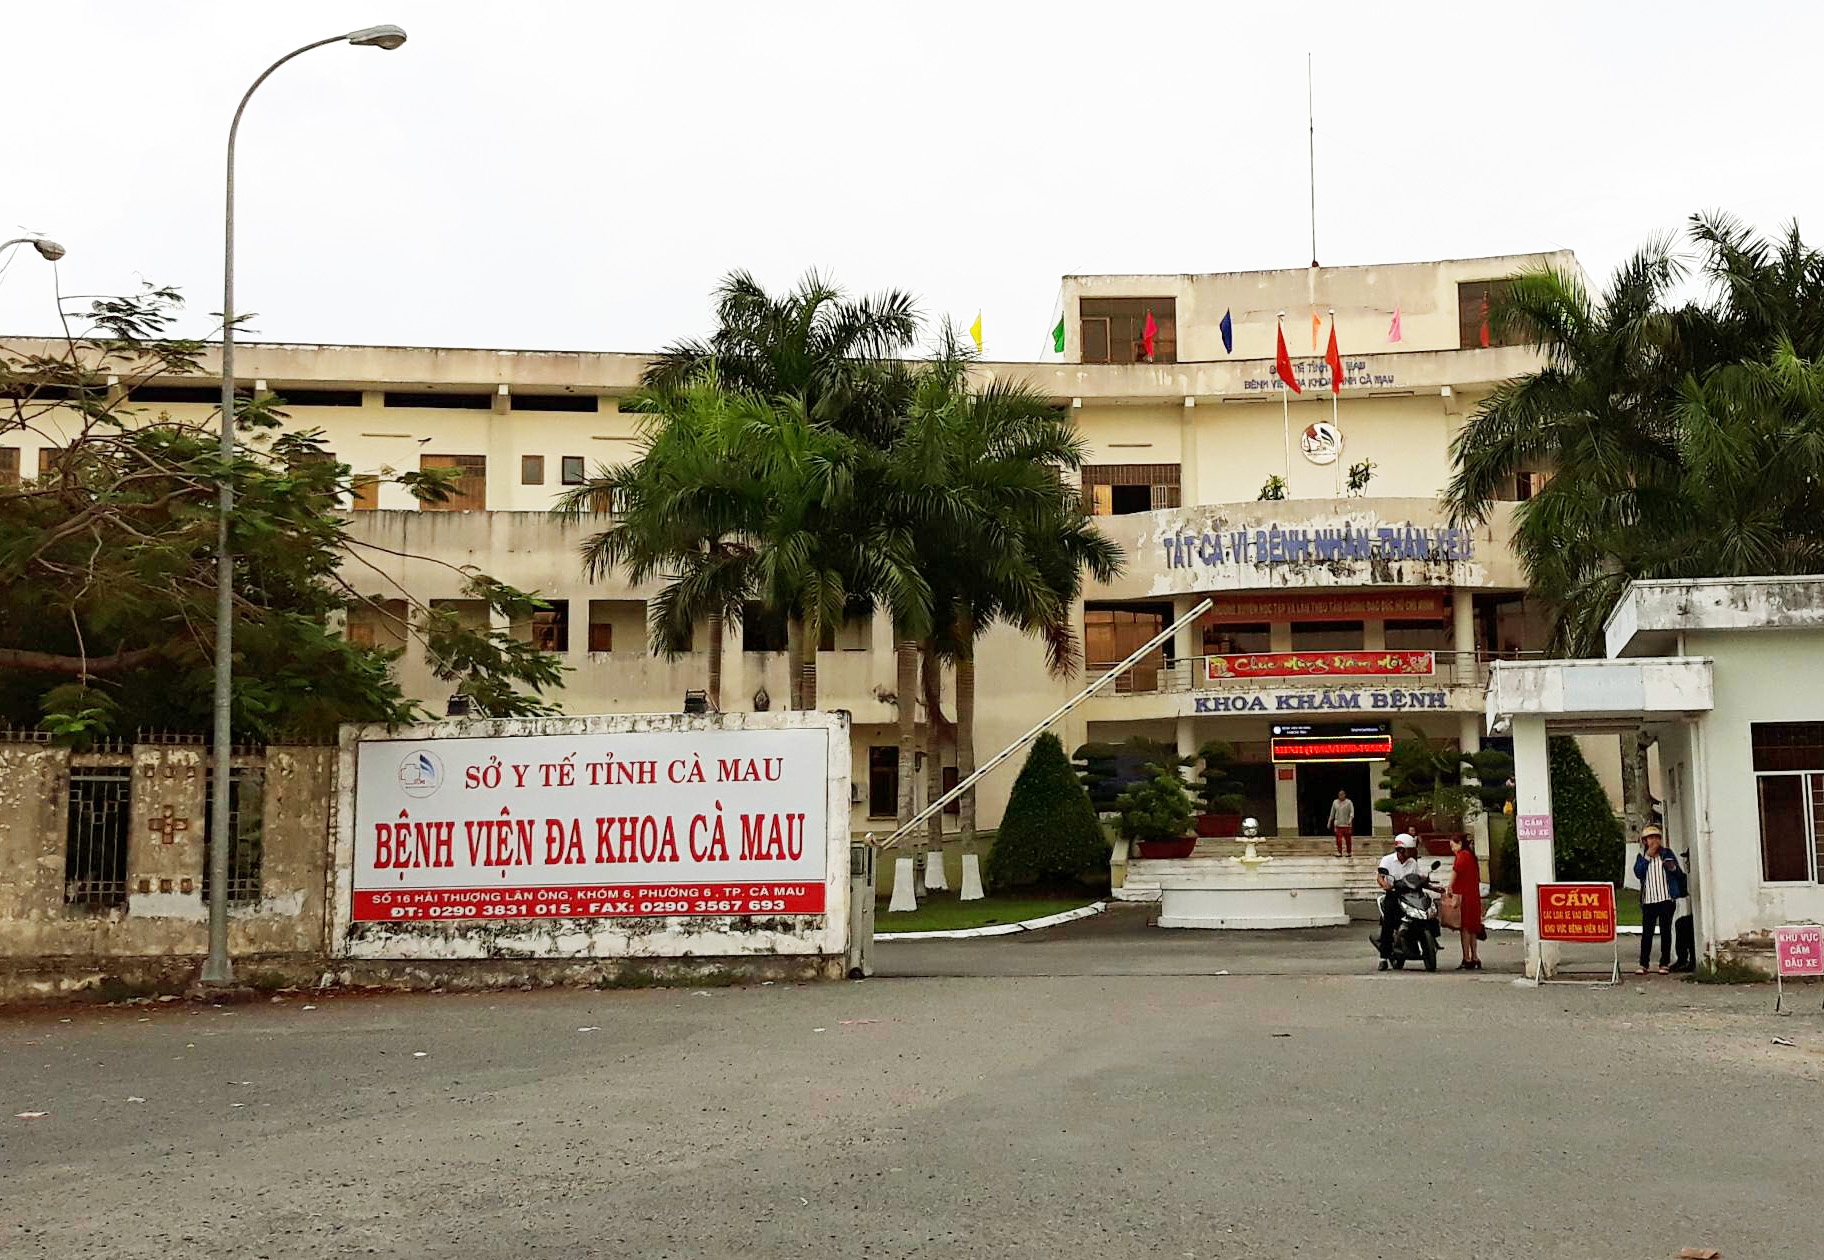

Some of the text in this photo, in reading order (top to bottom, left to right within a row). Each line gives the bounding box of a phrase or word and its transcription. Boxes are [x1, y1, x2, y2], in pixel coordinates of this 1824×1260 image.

[1194, 696, 1268, 713] KHOA
[465, 752, 784, 790] SỞ Y TẾ TỈNH CÀ MAU
[373, 799, 806, 881] BỆNH VIỆN ĐA KHOA CÀ MAU
[372, 891, 392, 904] SỐ
[396, 894, 411, 904] 16
[442, 891, 501, 905] THƯỢNG
[577, 888, 620, 900] KHÓM
[639, 886, 700, 899] PHƯỜNG
[750, 885, 769, 897] CÀ
[773, 886, 806, 897] MAU
[1550, 888, 1600, 907] CẤM
[390, 906, 424, 918] ĐT:
[429, 905, 477, 917] 0290
[482, 904, 528, 916] 3831
[535, 903, 571, 914] 015
[589, 902, 635, 914] FAX:
[640, 901, 689, 913] 0290
[694, 900, 744, 912] 3567
[749, 900, 786, 911] 693
[1780, 933, 1798, 942] KHU
[1806, 958, 1819, 967] XE
